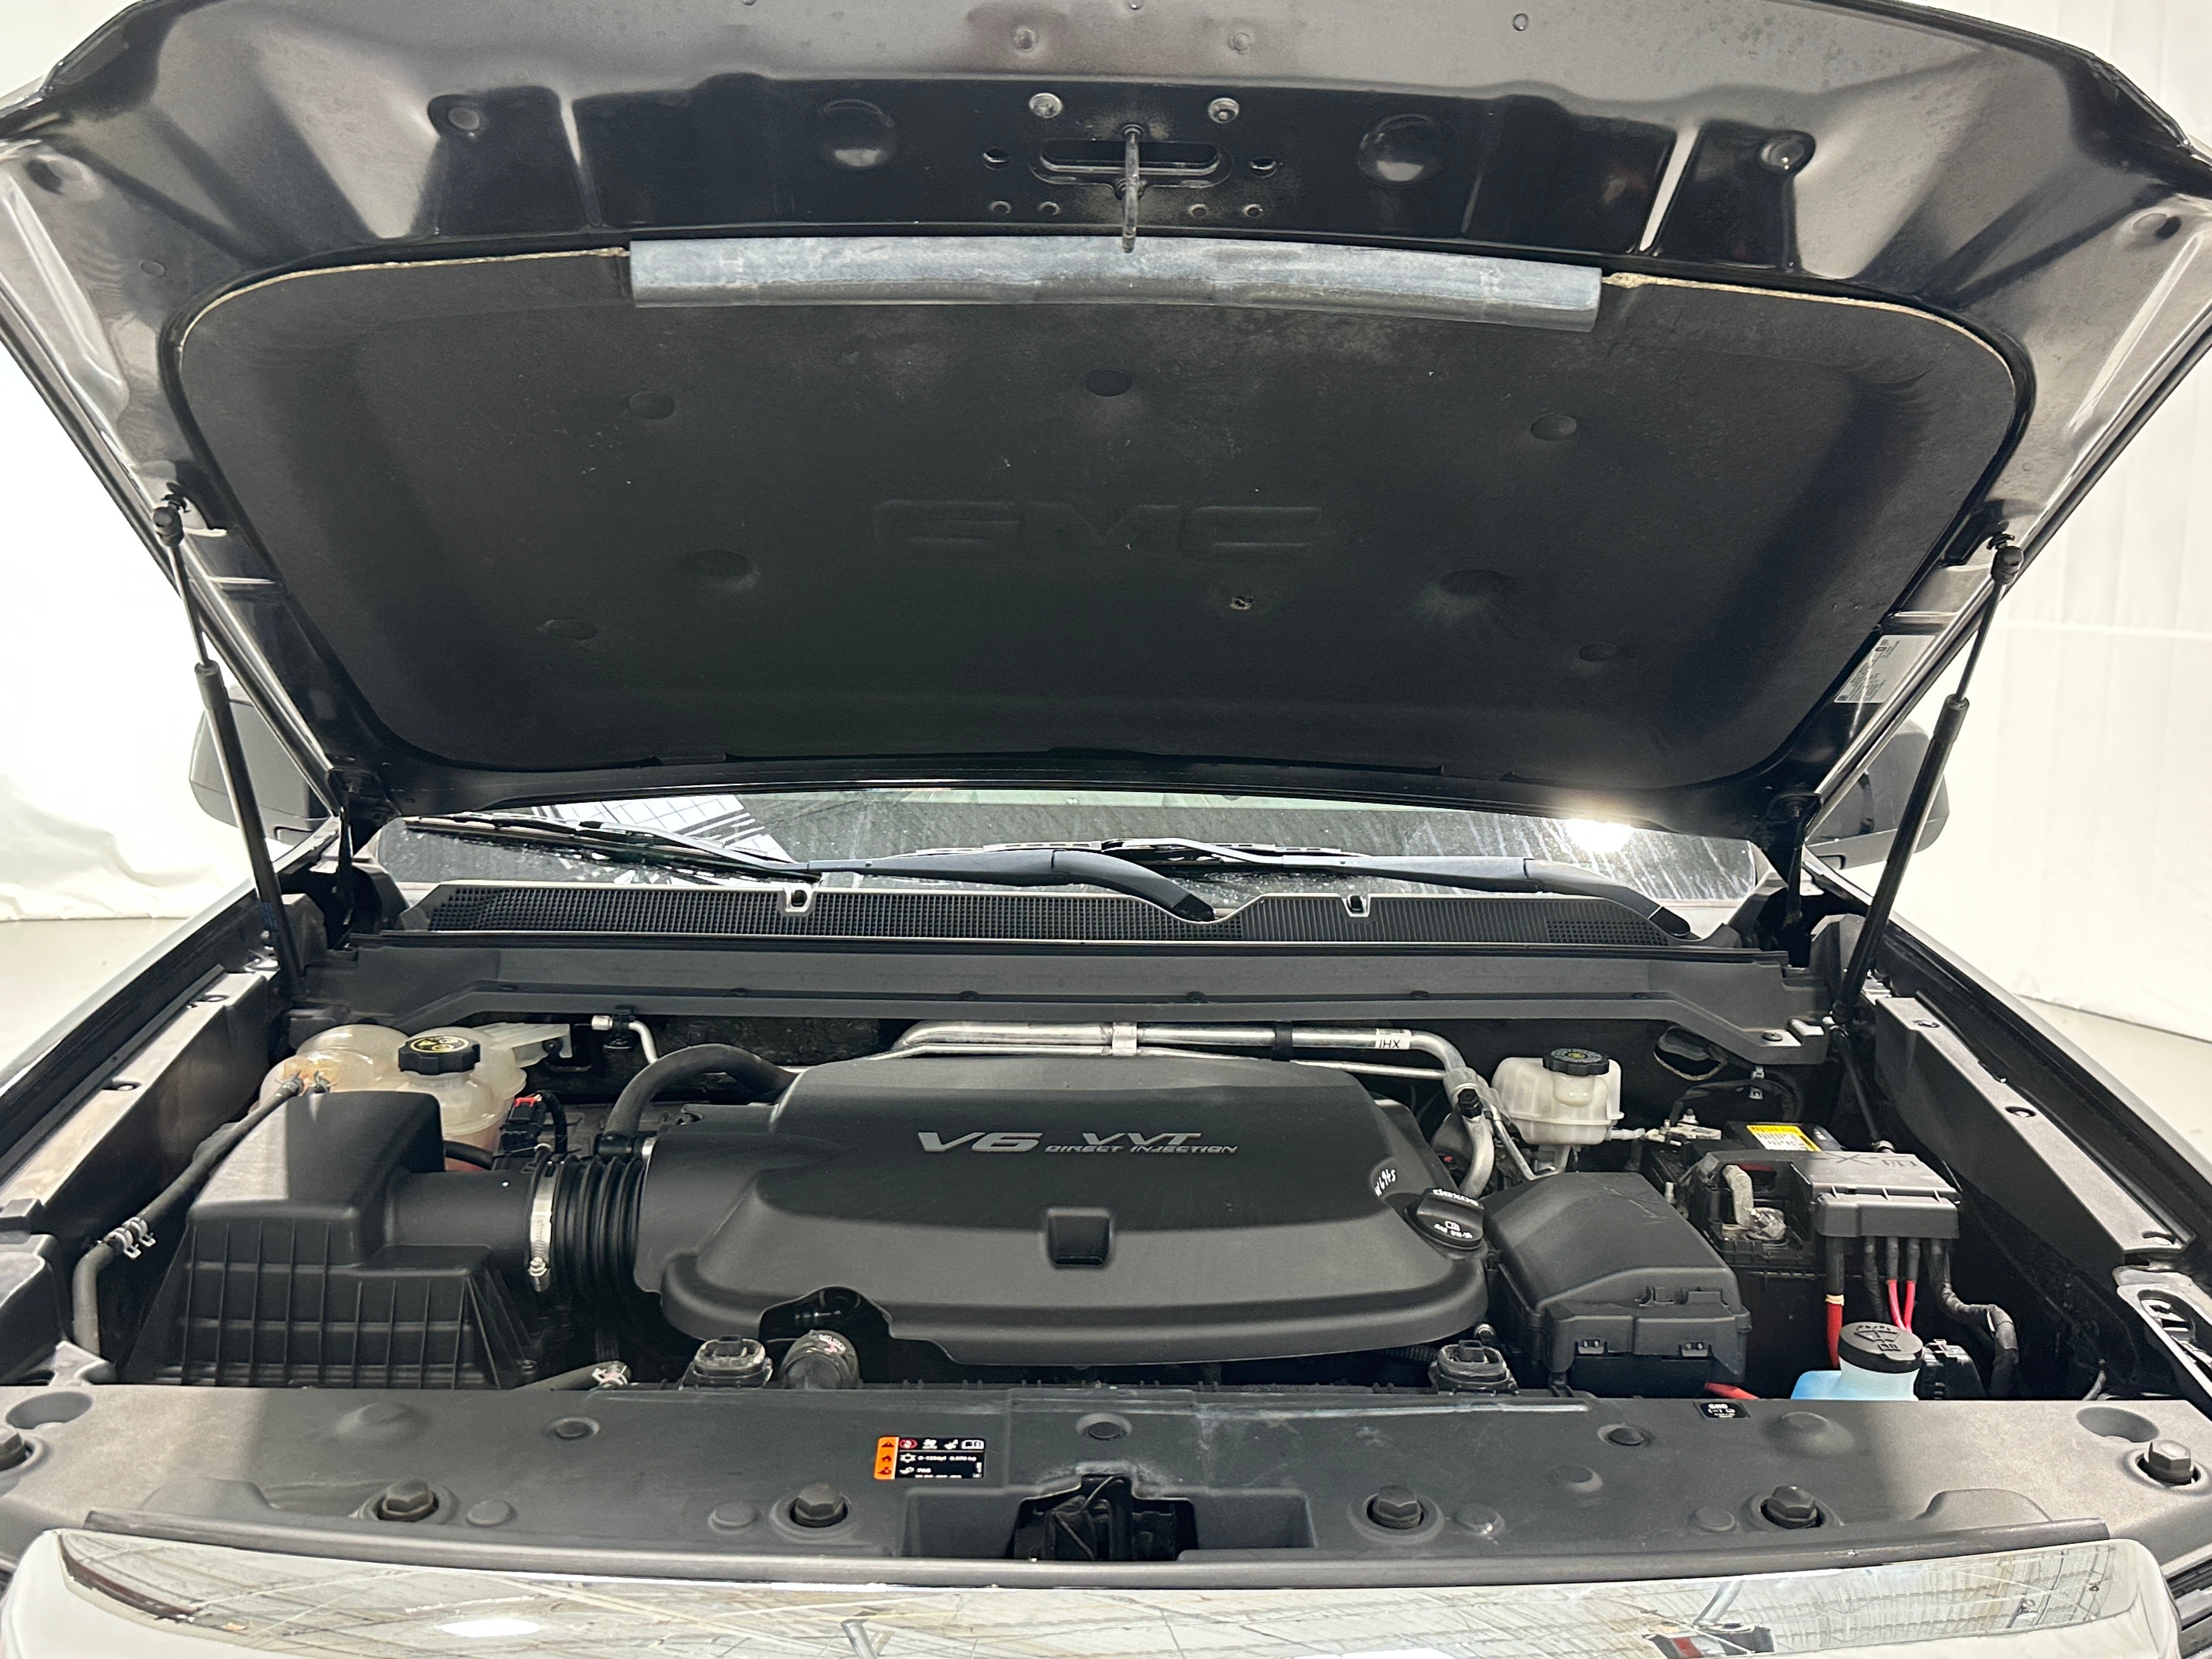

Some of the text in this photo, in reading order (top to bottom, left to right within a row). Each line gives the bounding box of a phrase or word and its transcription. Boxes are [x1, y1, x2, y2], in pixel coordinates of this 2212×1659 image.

[873, 498, 1323, 558] GMC
[918, 1132, 1202, 1152] V6 VVT
[1130, 1145, 1238, 1153] INJECTION
